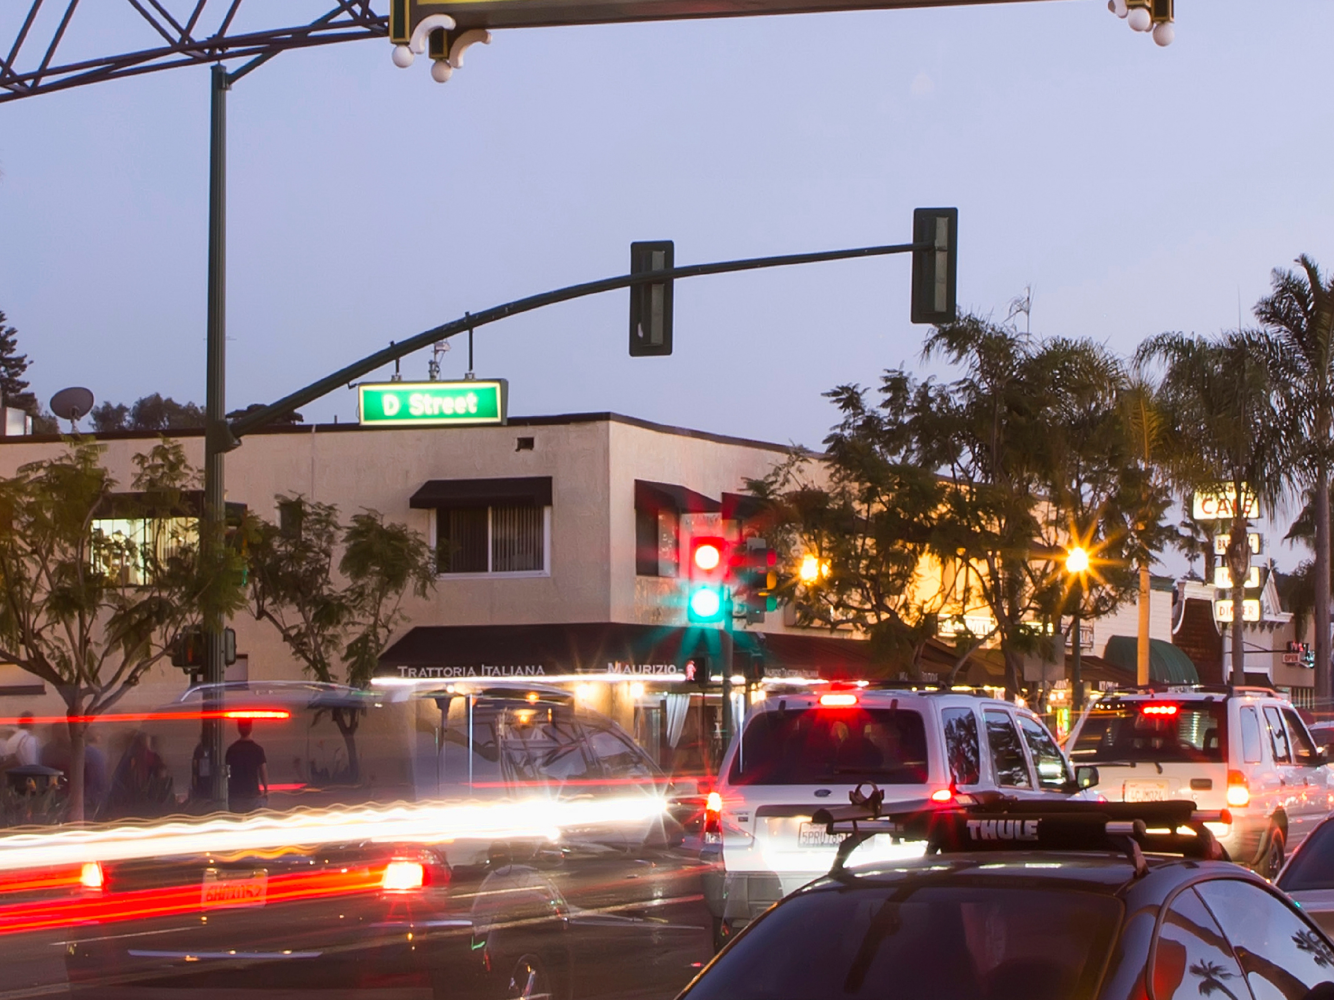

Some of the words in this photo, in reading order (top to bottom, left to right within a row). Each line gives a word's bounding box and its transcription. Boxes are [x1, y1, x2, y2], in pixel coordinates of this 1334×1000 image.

[383, 394, 400, 416] D
[409, 392, 478, 416] Street
[1201, 497, 1253, 515] CAE
[397, 666, 476, 678] TRATTORIA
[481, 664, 545, 676] ITALIANA
[967, 819, 1039, 841] THULE
